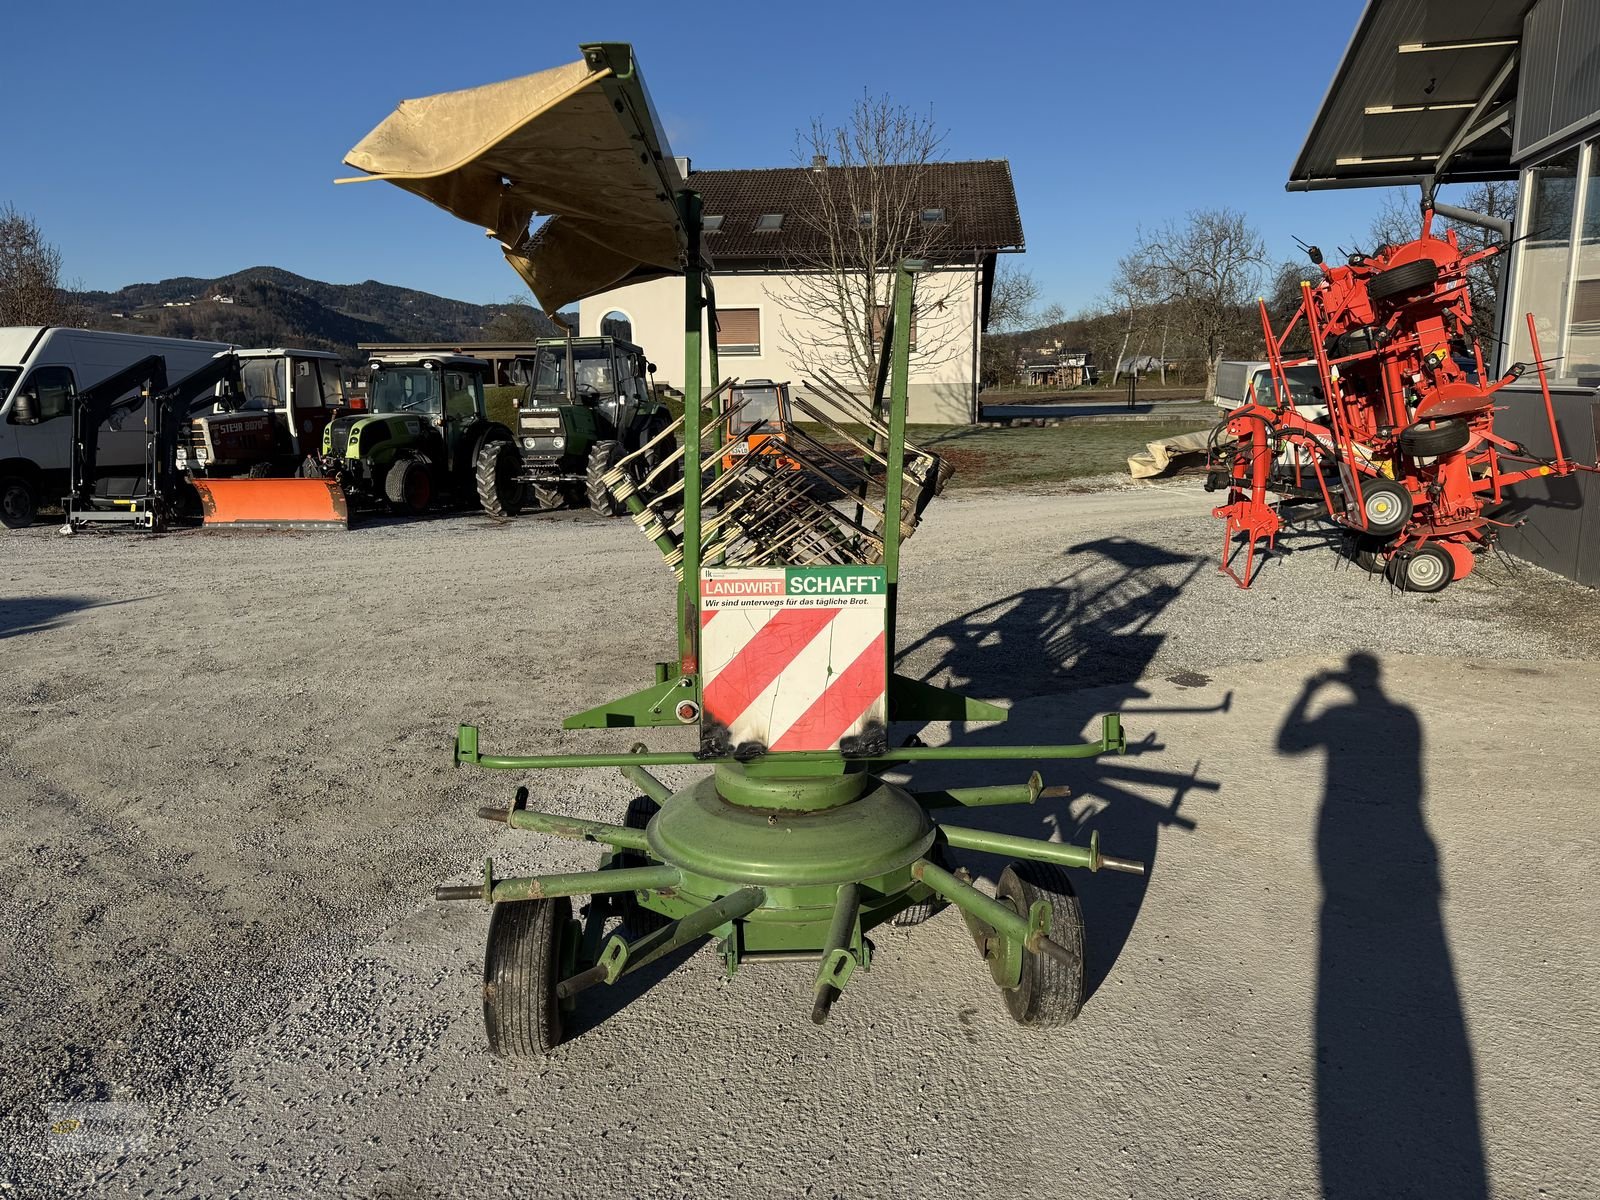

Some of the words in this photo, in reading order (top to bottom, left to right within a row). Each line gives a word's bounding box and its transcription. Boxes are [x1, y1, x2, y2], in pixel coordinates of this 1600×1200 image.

[219, 422, 243, 434] STEYR
[705, 581, 782, 595] LANDWIRT
[790, 575, 881, 593] SCHAFFT
[705, 599, 720, 607] Wir
[721, 599, 739, 607] sind
[740, 599, 784, 609] unterwegs
[785, 598, 798, 606] für
[799, 598, 814, 606] das
[816, 597, 848, 607] tägliche
[849, 597, 869, 605] Brot.
